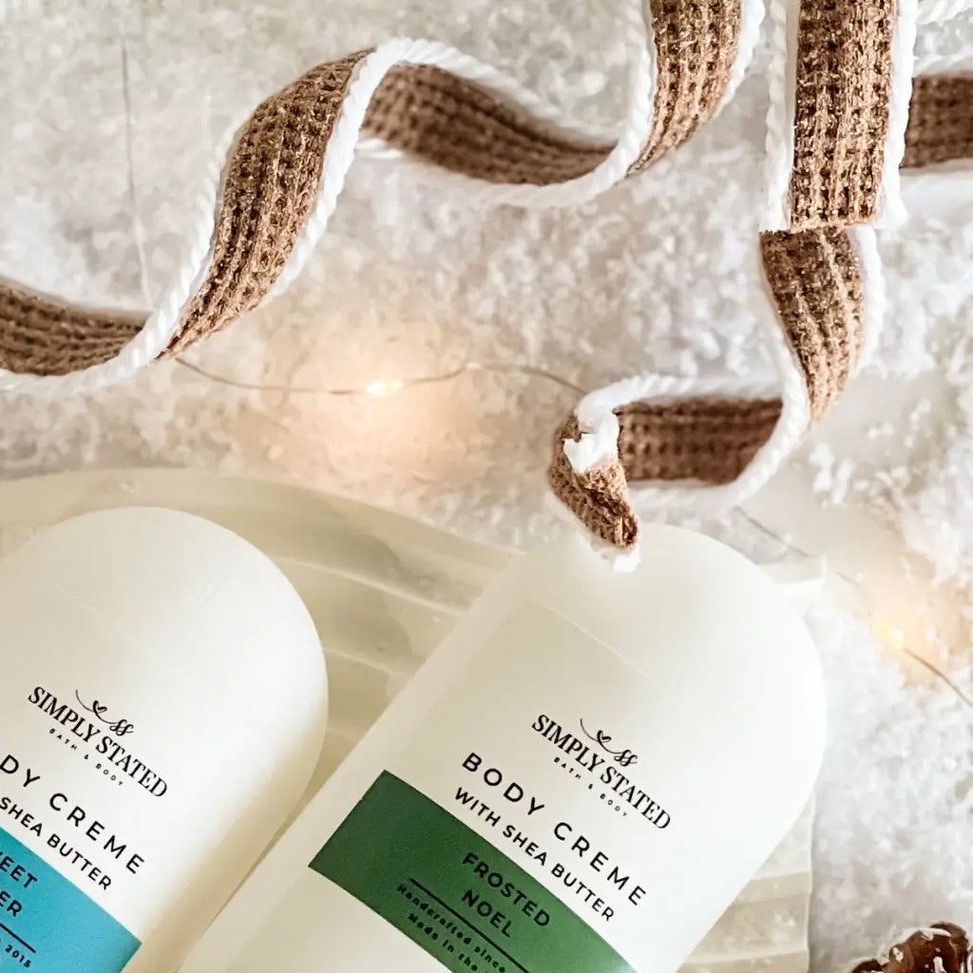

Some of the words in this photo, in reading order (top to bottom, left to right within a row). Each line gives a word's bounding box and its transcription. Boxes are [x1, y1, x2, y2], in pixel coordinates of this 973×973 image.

[28, 687, 101, 744] SIMPLY
[95, 737, 167, 797] STATED
[531, 714, 605, 774] SIMPLY
[600, 765, 671, 830] STATED
[47, 834, 112, 890] BUTTER
[50, 793, 144, 873] CREME
[455, 787, 501, 828] WITH
[502, 825, 548, 866] SHEA
[552, 864, 615, 921] BUTTER
[462, 753, 544, 816] BODY
[554, 822, 646, 906] CREME
[397, 884, 472, 946] Handcrafted
[474, 944, 506, 973] since
[462, 853, 550, 927] FROSTED
[462, 890, 512, 938] NOEL
[5, 944, 32, 968] 2015
[407, 912, 439, 941] Made
[443, 939, 456, 952] in
[458, 952, 479, 973] the
